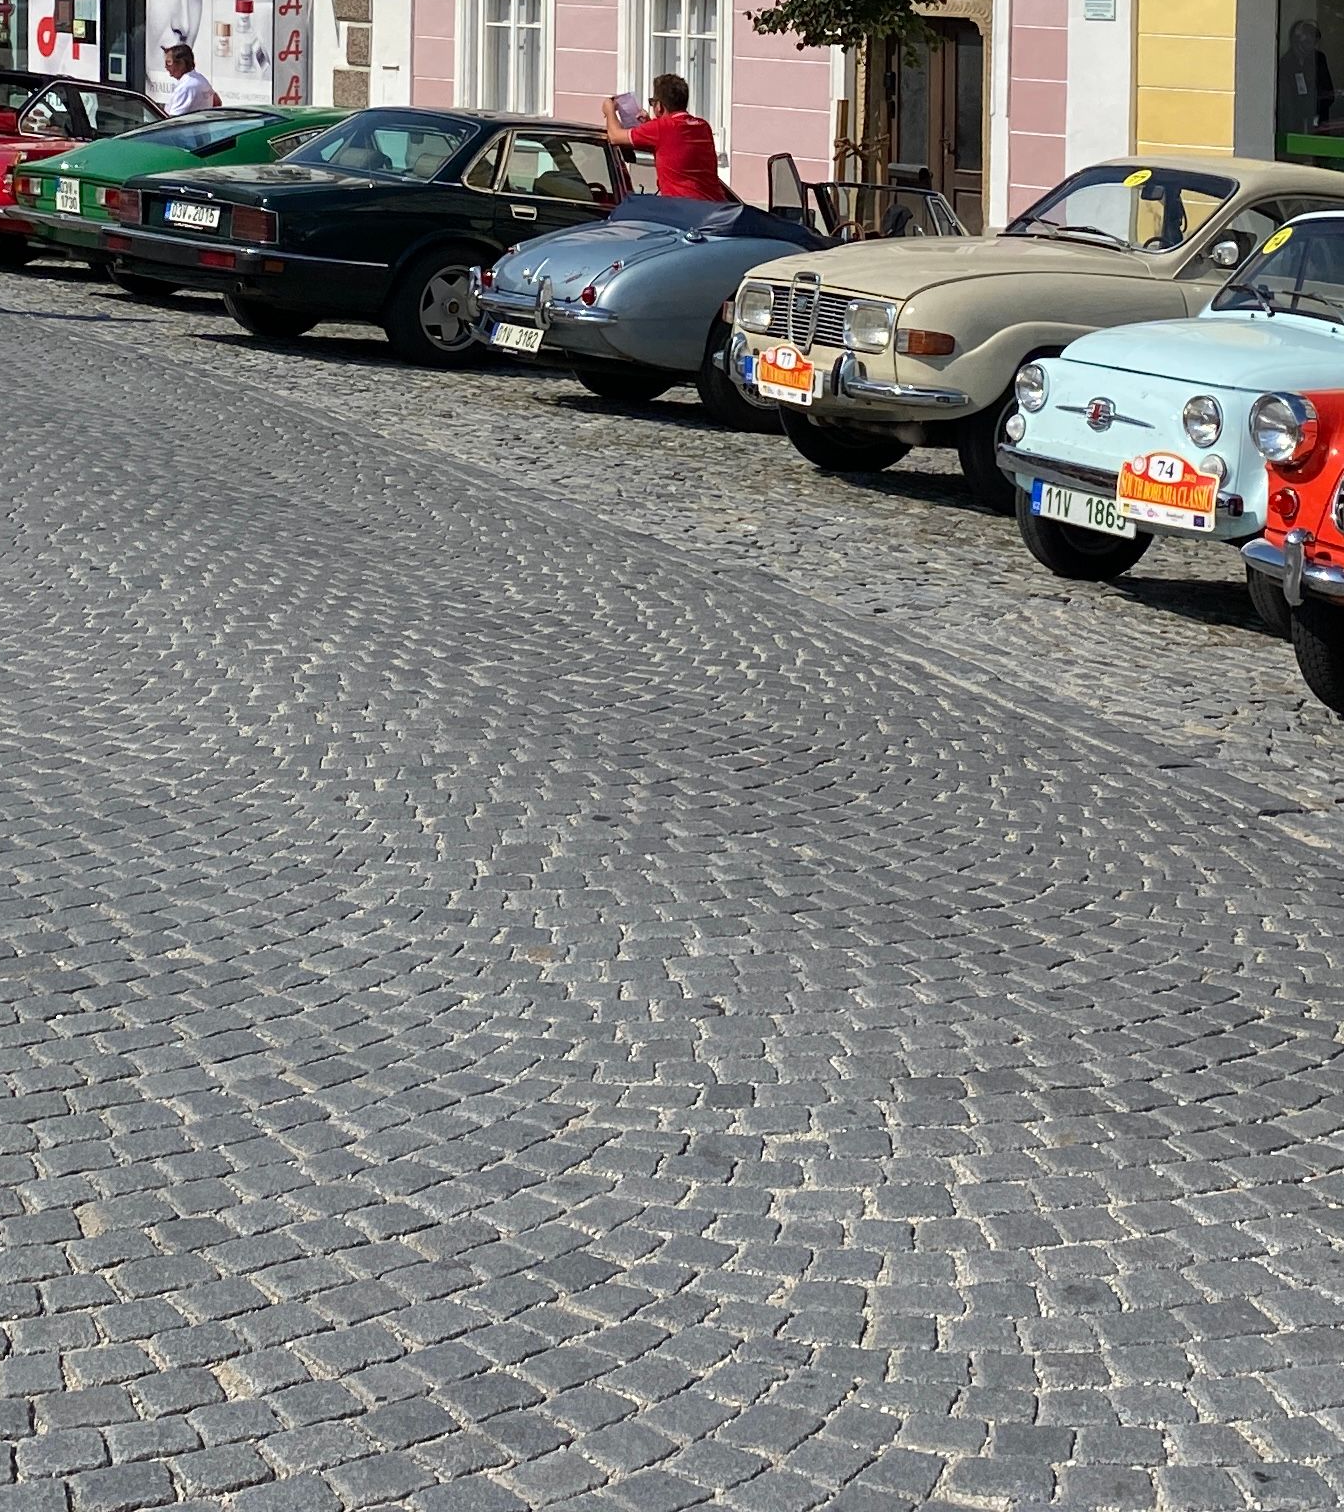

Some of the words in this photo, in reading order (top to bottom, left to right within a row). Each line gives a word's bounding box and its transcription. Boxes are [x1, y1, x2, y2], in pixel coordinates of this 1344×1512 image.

[781, 352, 792, 366] 77
[1157, 459, 1175, 479] 74
[1046, 487, 1073, 518] 11V
[1119, 470, 1143, 501] SOUTH
[1144, 481, 1177, 507] BOHEMIA
[1177, 485, 1214, 512] CLASSIC
